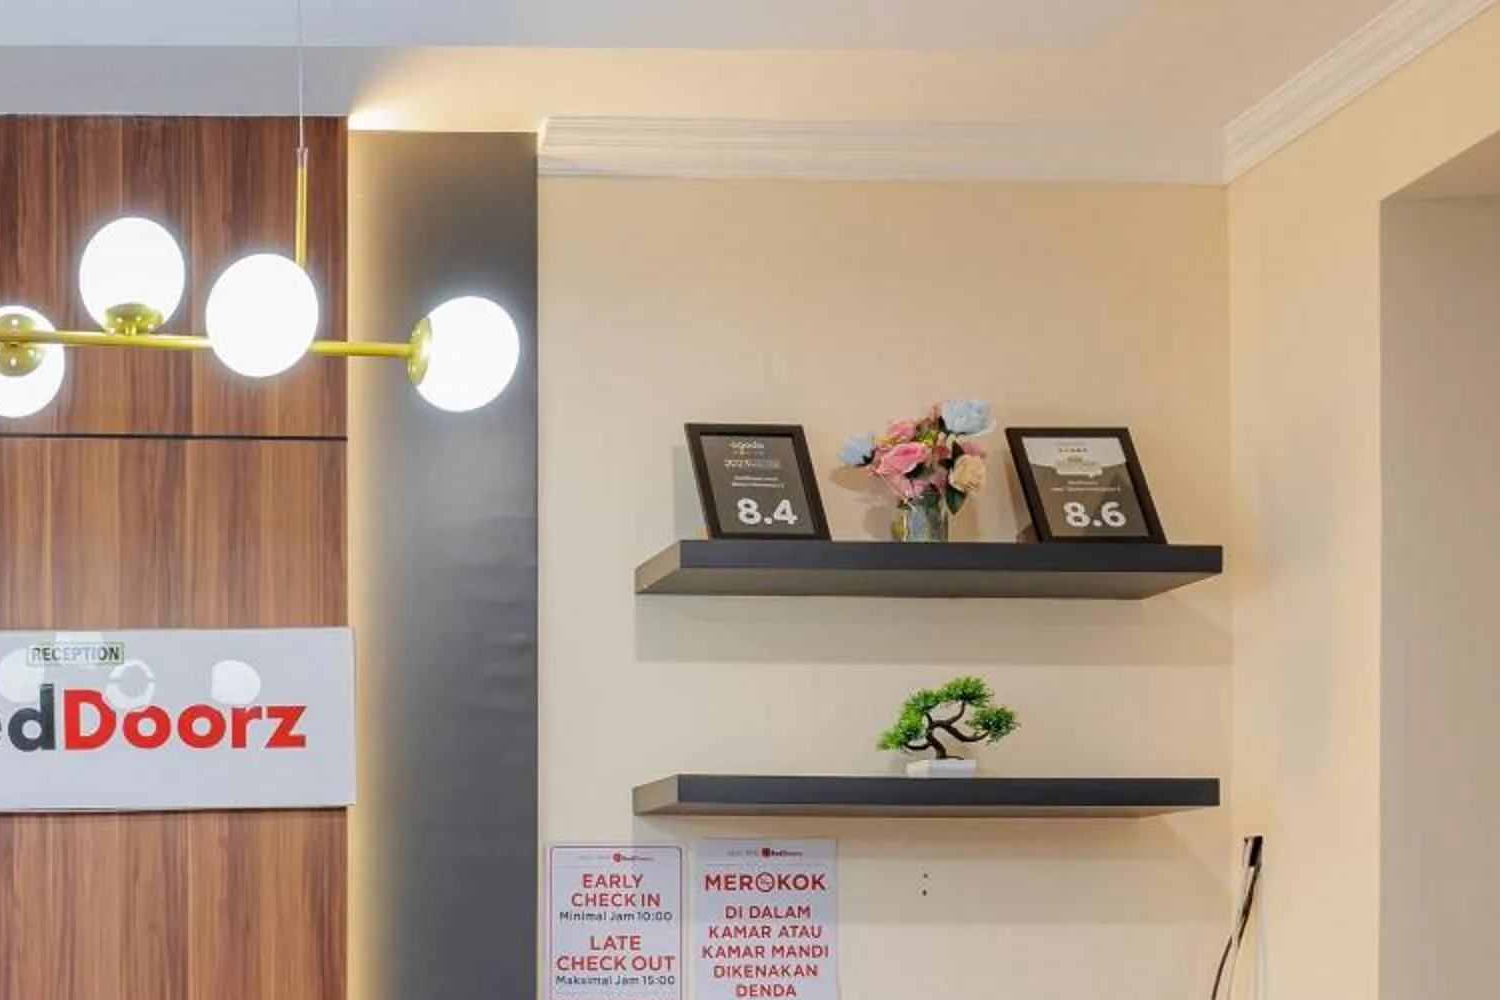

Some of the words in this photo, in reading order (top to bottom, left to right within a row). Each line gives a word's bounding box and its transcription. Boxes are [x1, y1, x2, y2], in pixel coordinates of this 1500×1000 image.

[737, 498, 798, 525] 8.4
[1063, 501, 1127, 527] 8.6
[31, 647, 120, 661] RECEPTION
[582, 874, 643, 889] EARLY
[571, 893, 638, 907] CHECK
[641, 893, 660, 907] IN
[559, 912, 607, 921] Minimal
[609, 912, 634, 921] Jam
[637, 912, 672, 921] 10:00
[725, 906, 743, 918] DI
[749, 906, 810, 918] DALAM
[709, 926, 771, 939] KAMAR
[778, 926, 822, 939] ATAU
[590, 936, 641, 950] LATE
[702, 946, 765, 958] KAMAR
[771, 946, 829, 958] MANDI
[556, 956, 626, 971] CHECK
[632, 956, 675, 971] OUT
[714, 965, 817, 978] DIKENAKAN
[556, 975, 612, 986] Maksimal
[615, 975, 640, 986] Jam
[642, 975, 675, 986] 15:00
[736, 985, 796, 997] DENDA
